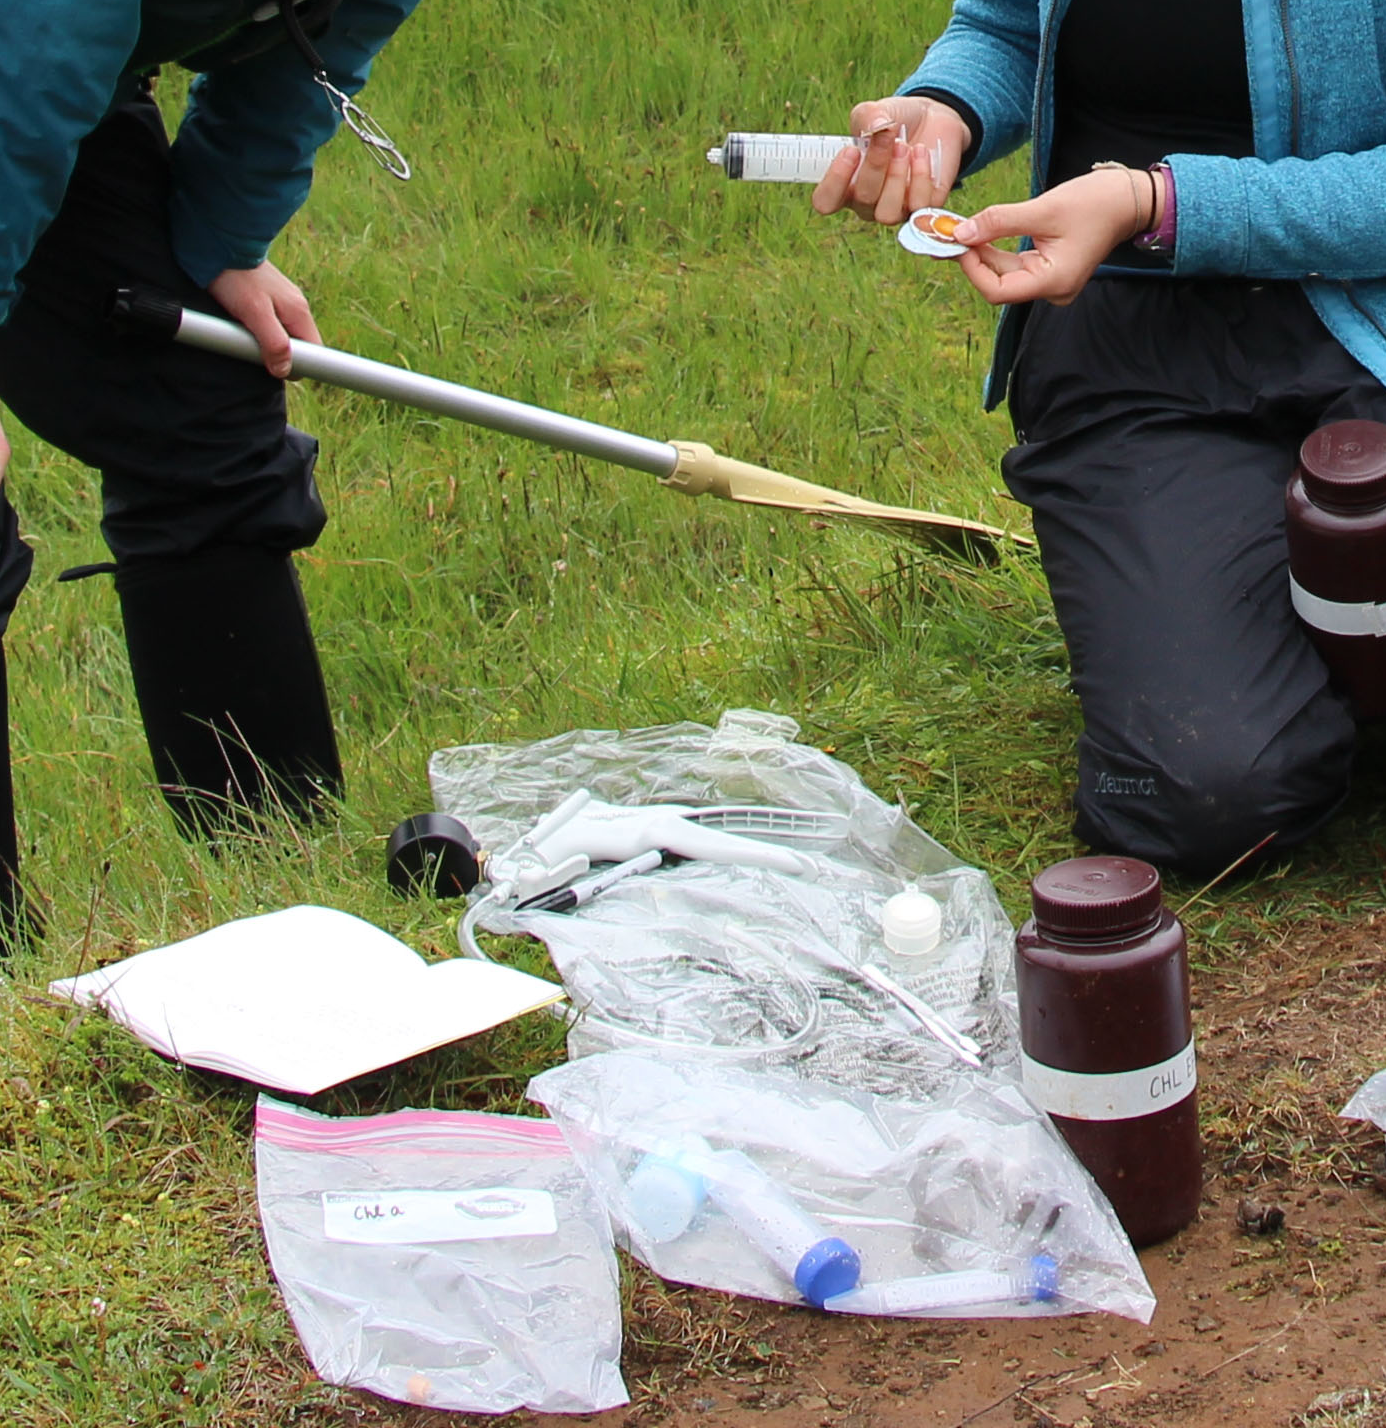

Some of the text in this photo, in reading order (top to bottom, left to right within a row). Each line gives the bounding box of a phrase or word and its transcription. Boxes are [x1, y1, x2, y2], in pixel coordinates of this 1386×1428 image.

[1095, 772, 1159, 795] Marmot
[1150, 1068, 1182, 1099] CHL
[390, 1204, 405, 1217] a
